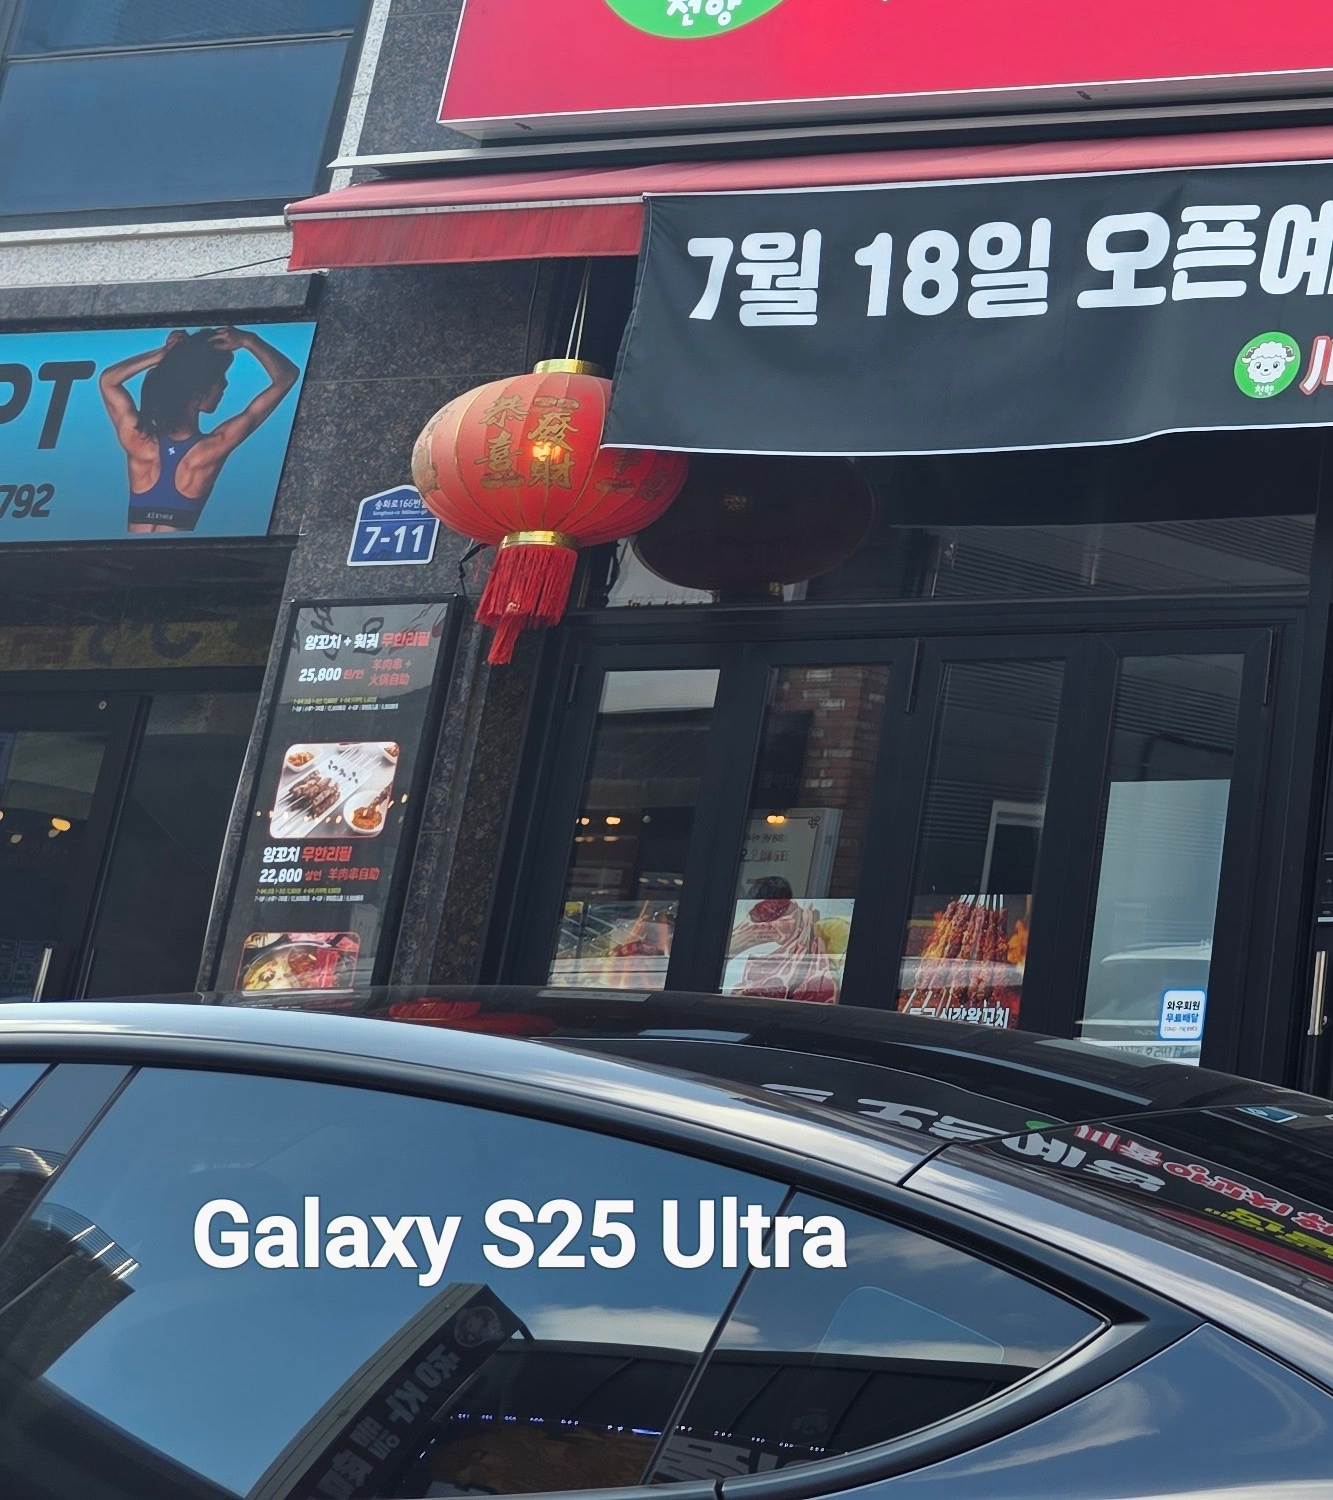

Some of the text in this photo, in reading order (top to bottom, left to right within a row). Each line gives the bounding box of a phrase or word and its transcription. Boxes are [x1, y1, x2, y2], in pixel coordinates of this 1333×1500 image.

[686, 227, 822, 328] 7월
[853, 218, 1051, 319] 18일
[0, 360, 96, 450] PT
[363, 525, 424, 554] 7-11
[298, 667, 342, 683] 25,800
[259, 868, 302, 885] 22,800
[1167, 1000, 1200, 1011] 와우회원
[1166, 1013, 1199, 1023] 무료배달
